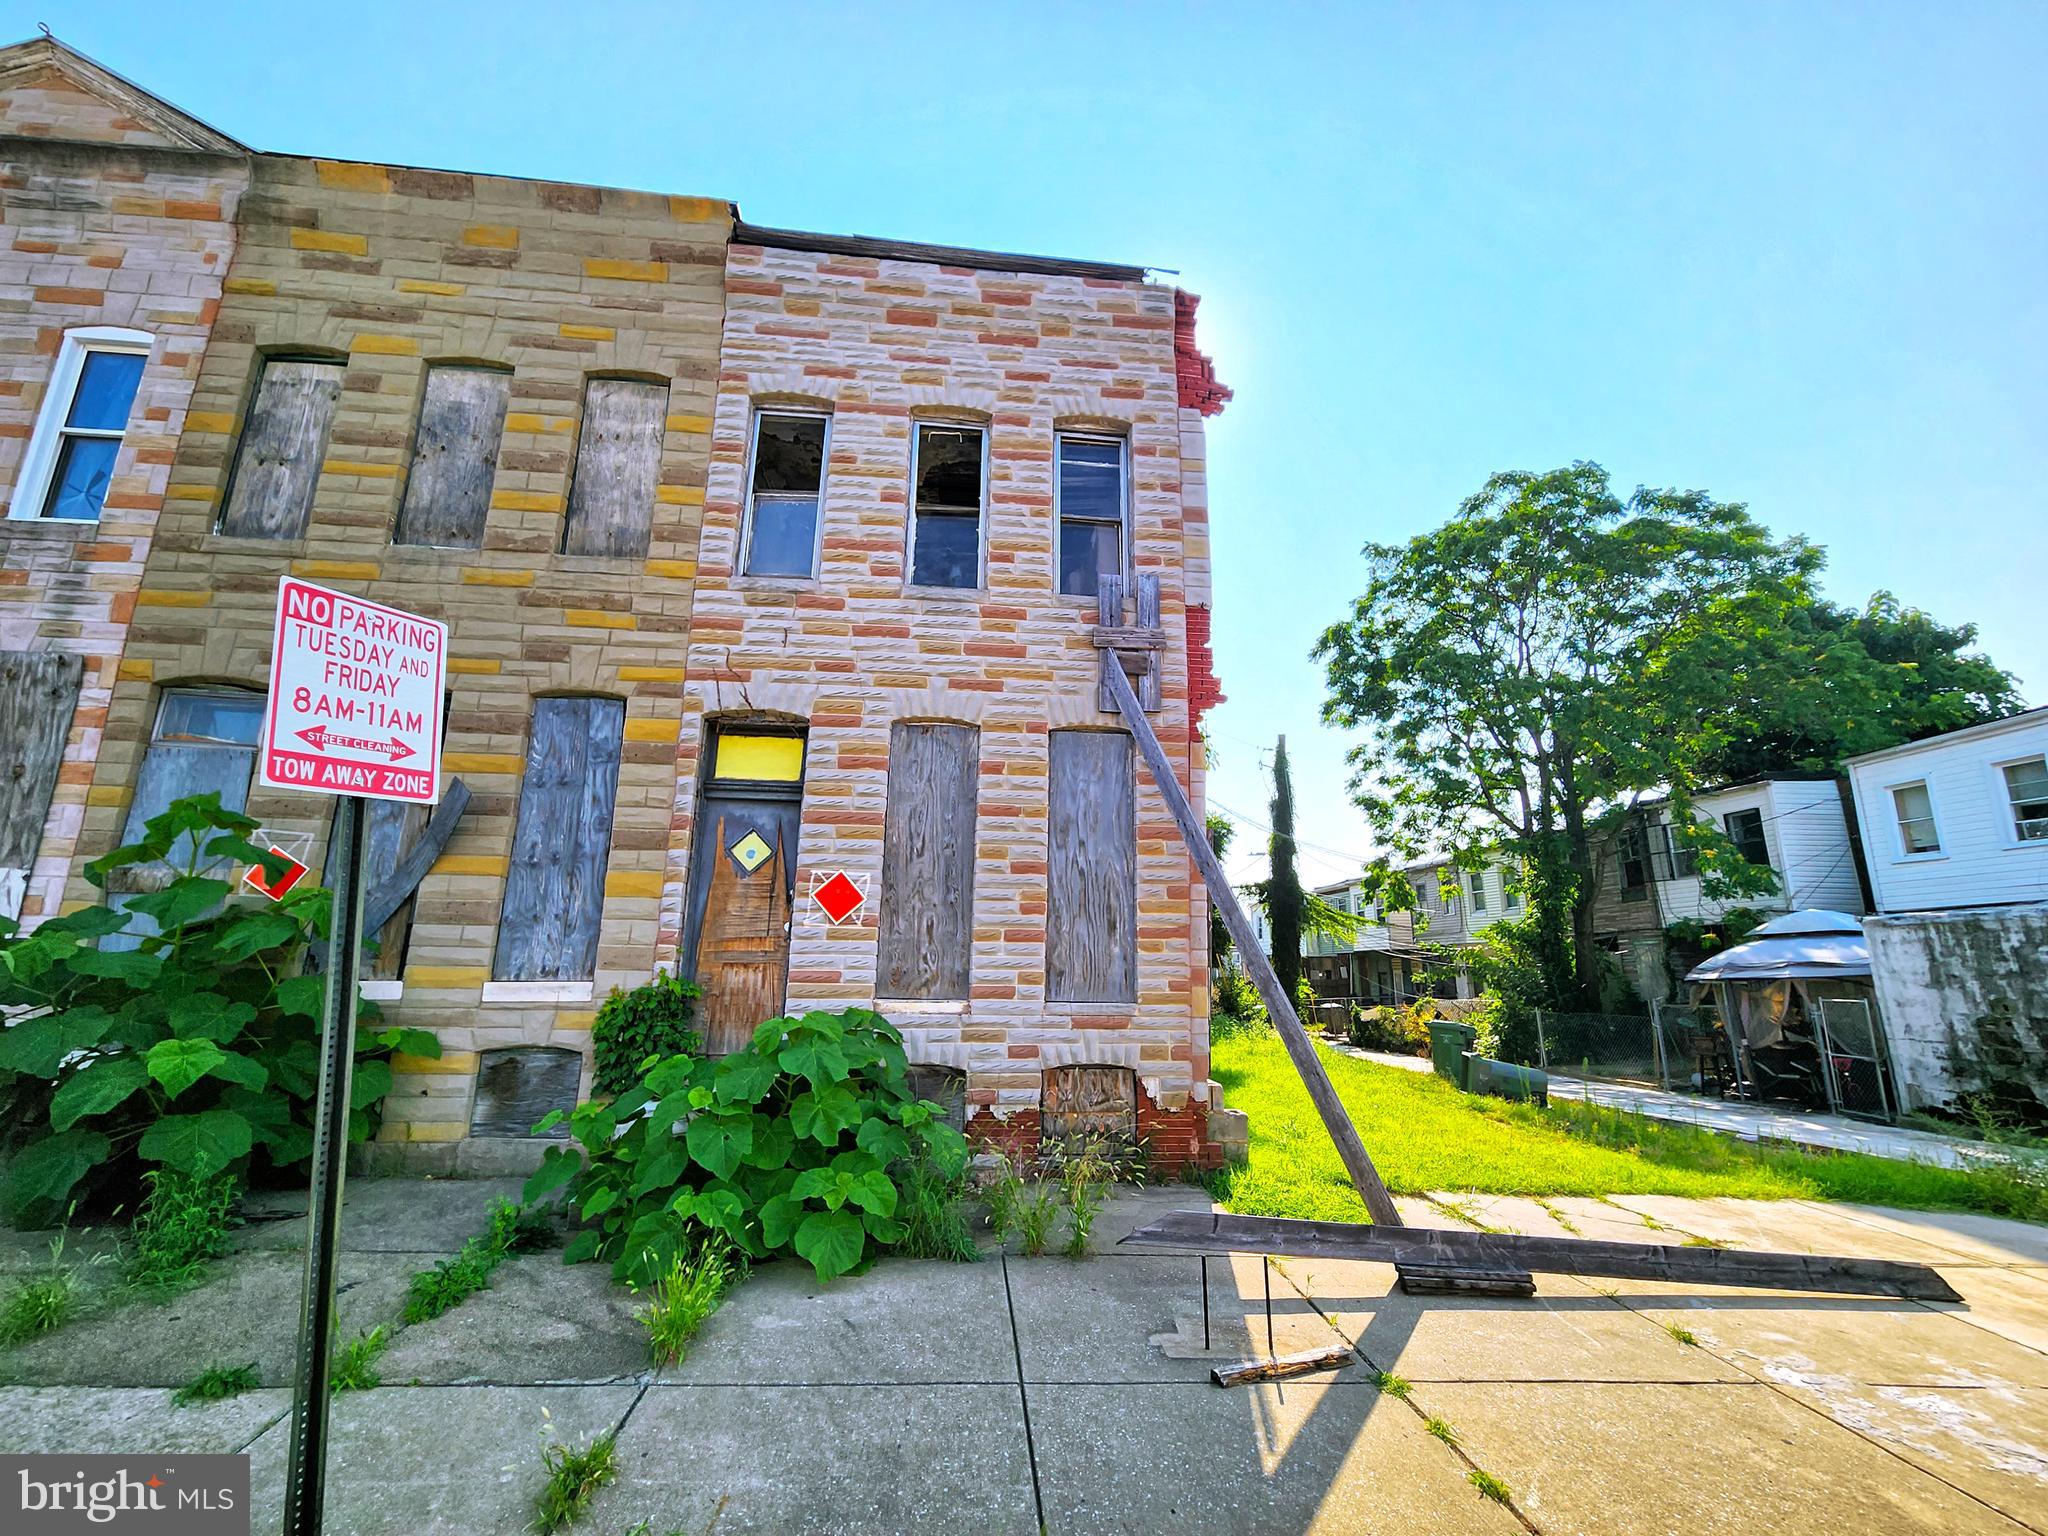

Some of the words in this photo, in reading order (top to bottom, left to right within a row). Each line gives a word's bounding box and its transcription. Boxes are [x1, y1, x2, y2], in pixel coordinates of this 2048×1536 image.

[289, 588, 330, 623] NO
[339, 605, 435, 653] PARKING
[295, 623, 394, 669] TUESDAY
[399, 656, 429, 678] AND
[324, 661, 401, 698] FRIDAY
[292, 687, 423, 735] 8AM-11AM
[307, 731, 350, 747] STREET
[353, 739, 406, 755] CLEANING
[272, 756, 316, 781] TOW
[321, 763, 377, 788] AWAY
[382, 771, 430, 795] ZONE
